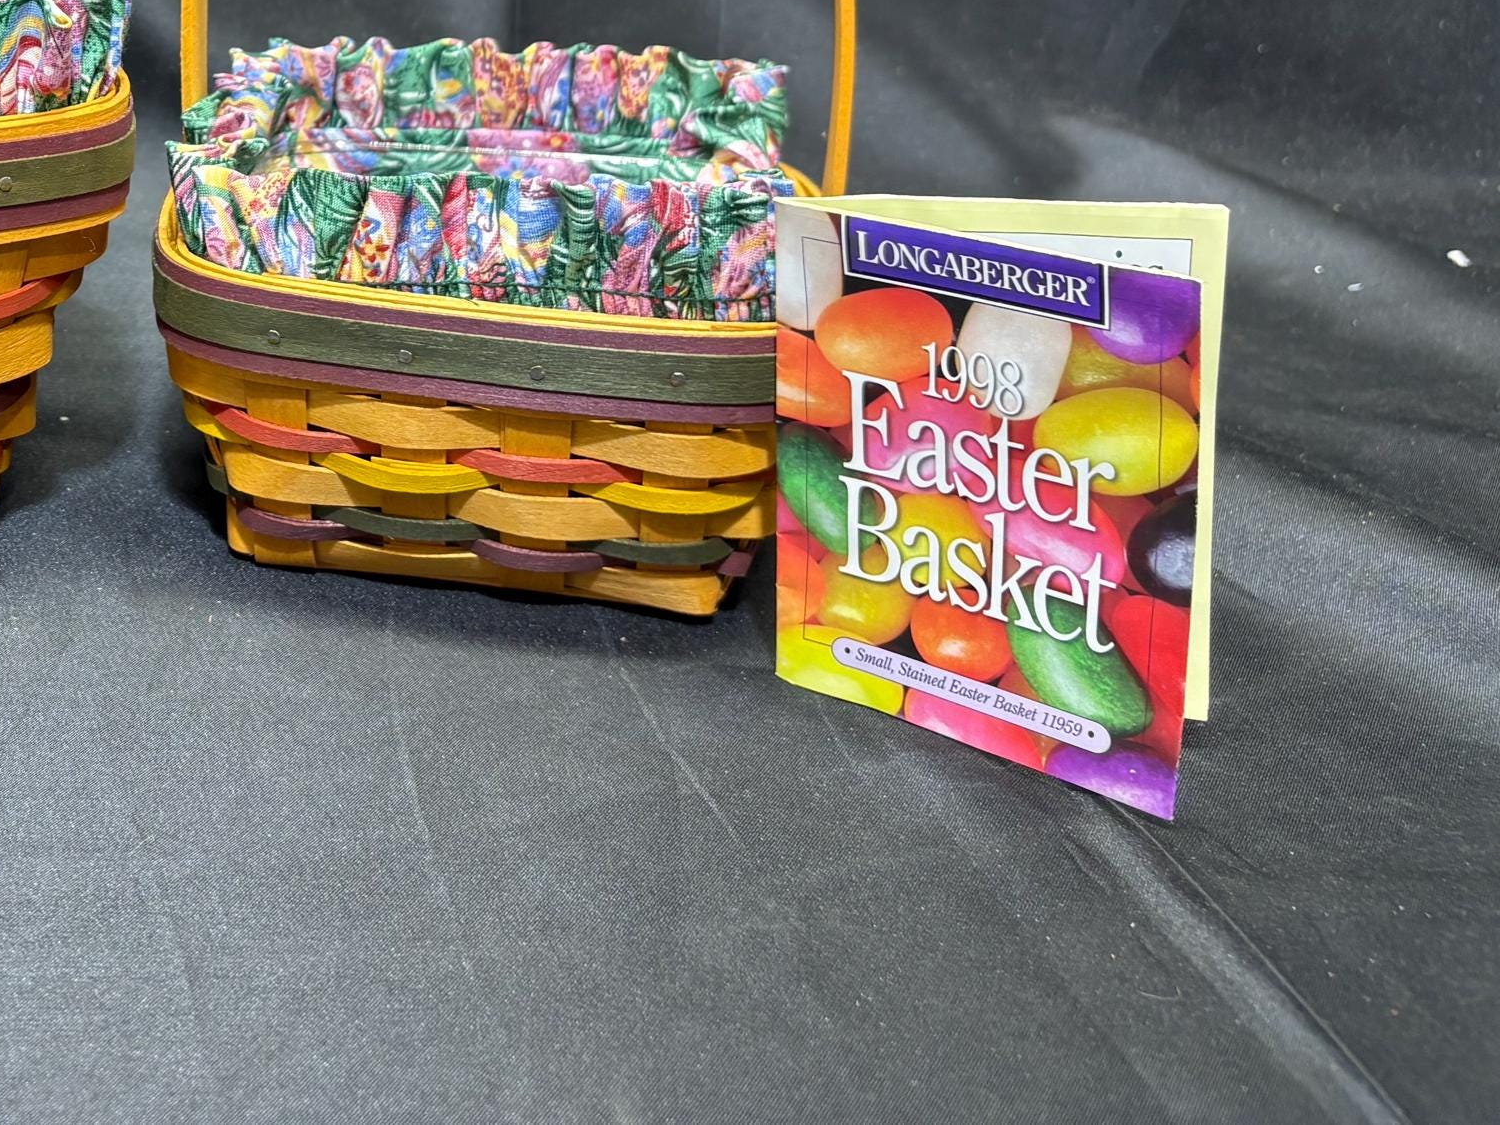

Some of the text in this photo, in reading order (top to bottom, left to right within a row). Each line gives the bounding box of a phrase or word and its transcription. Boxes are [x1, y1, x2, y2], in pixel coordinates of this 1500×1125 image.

[921, 341, 1024, 415] 1998
[842, 369, 1115, 532] Easter
[838, 475, 1116, 654] Basket
[855, 648, 1083, 737] Small, Stained Easter Basket 11959
